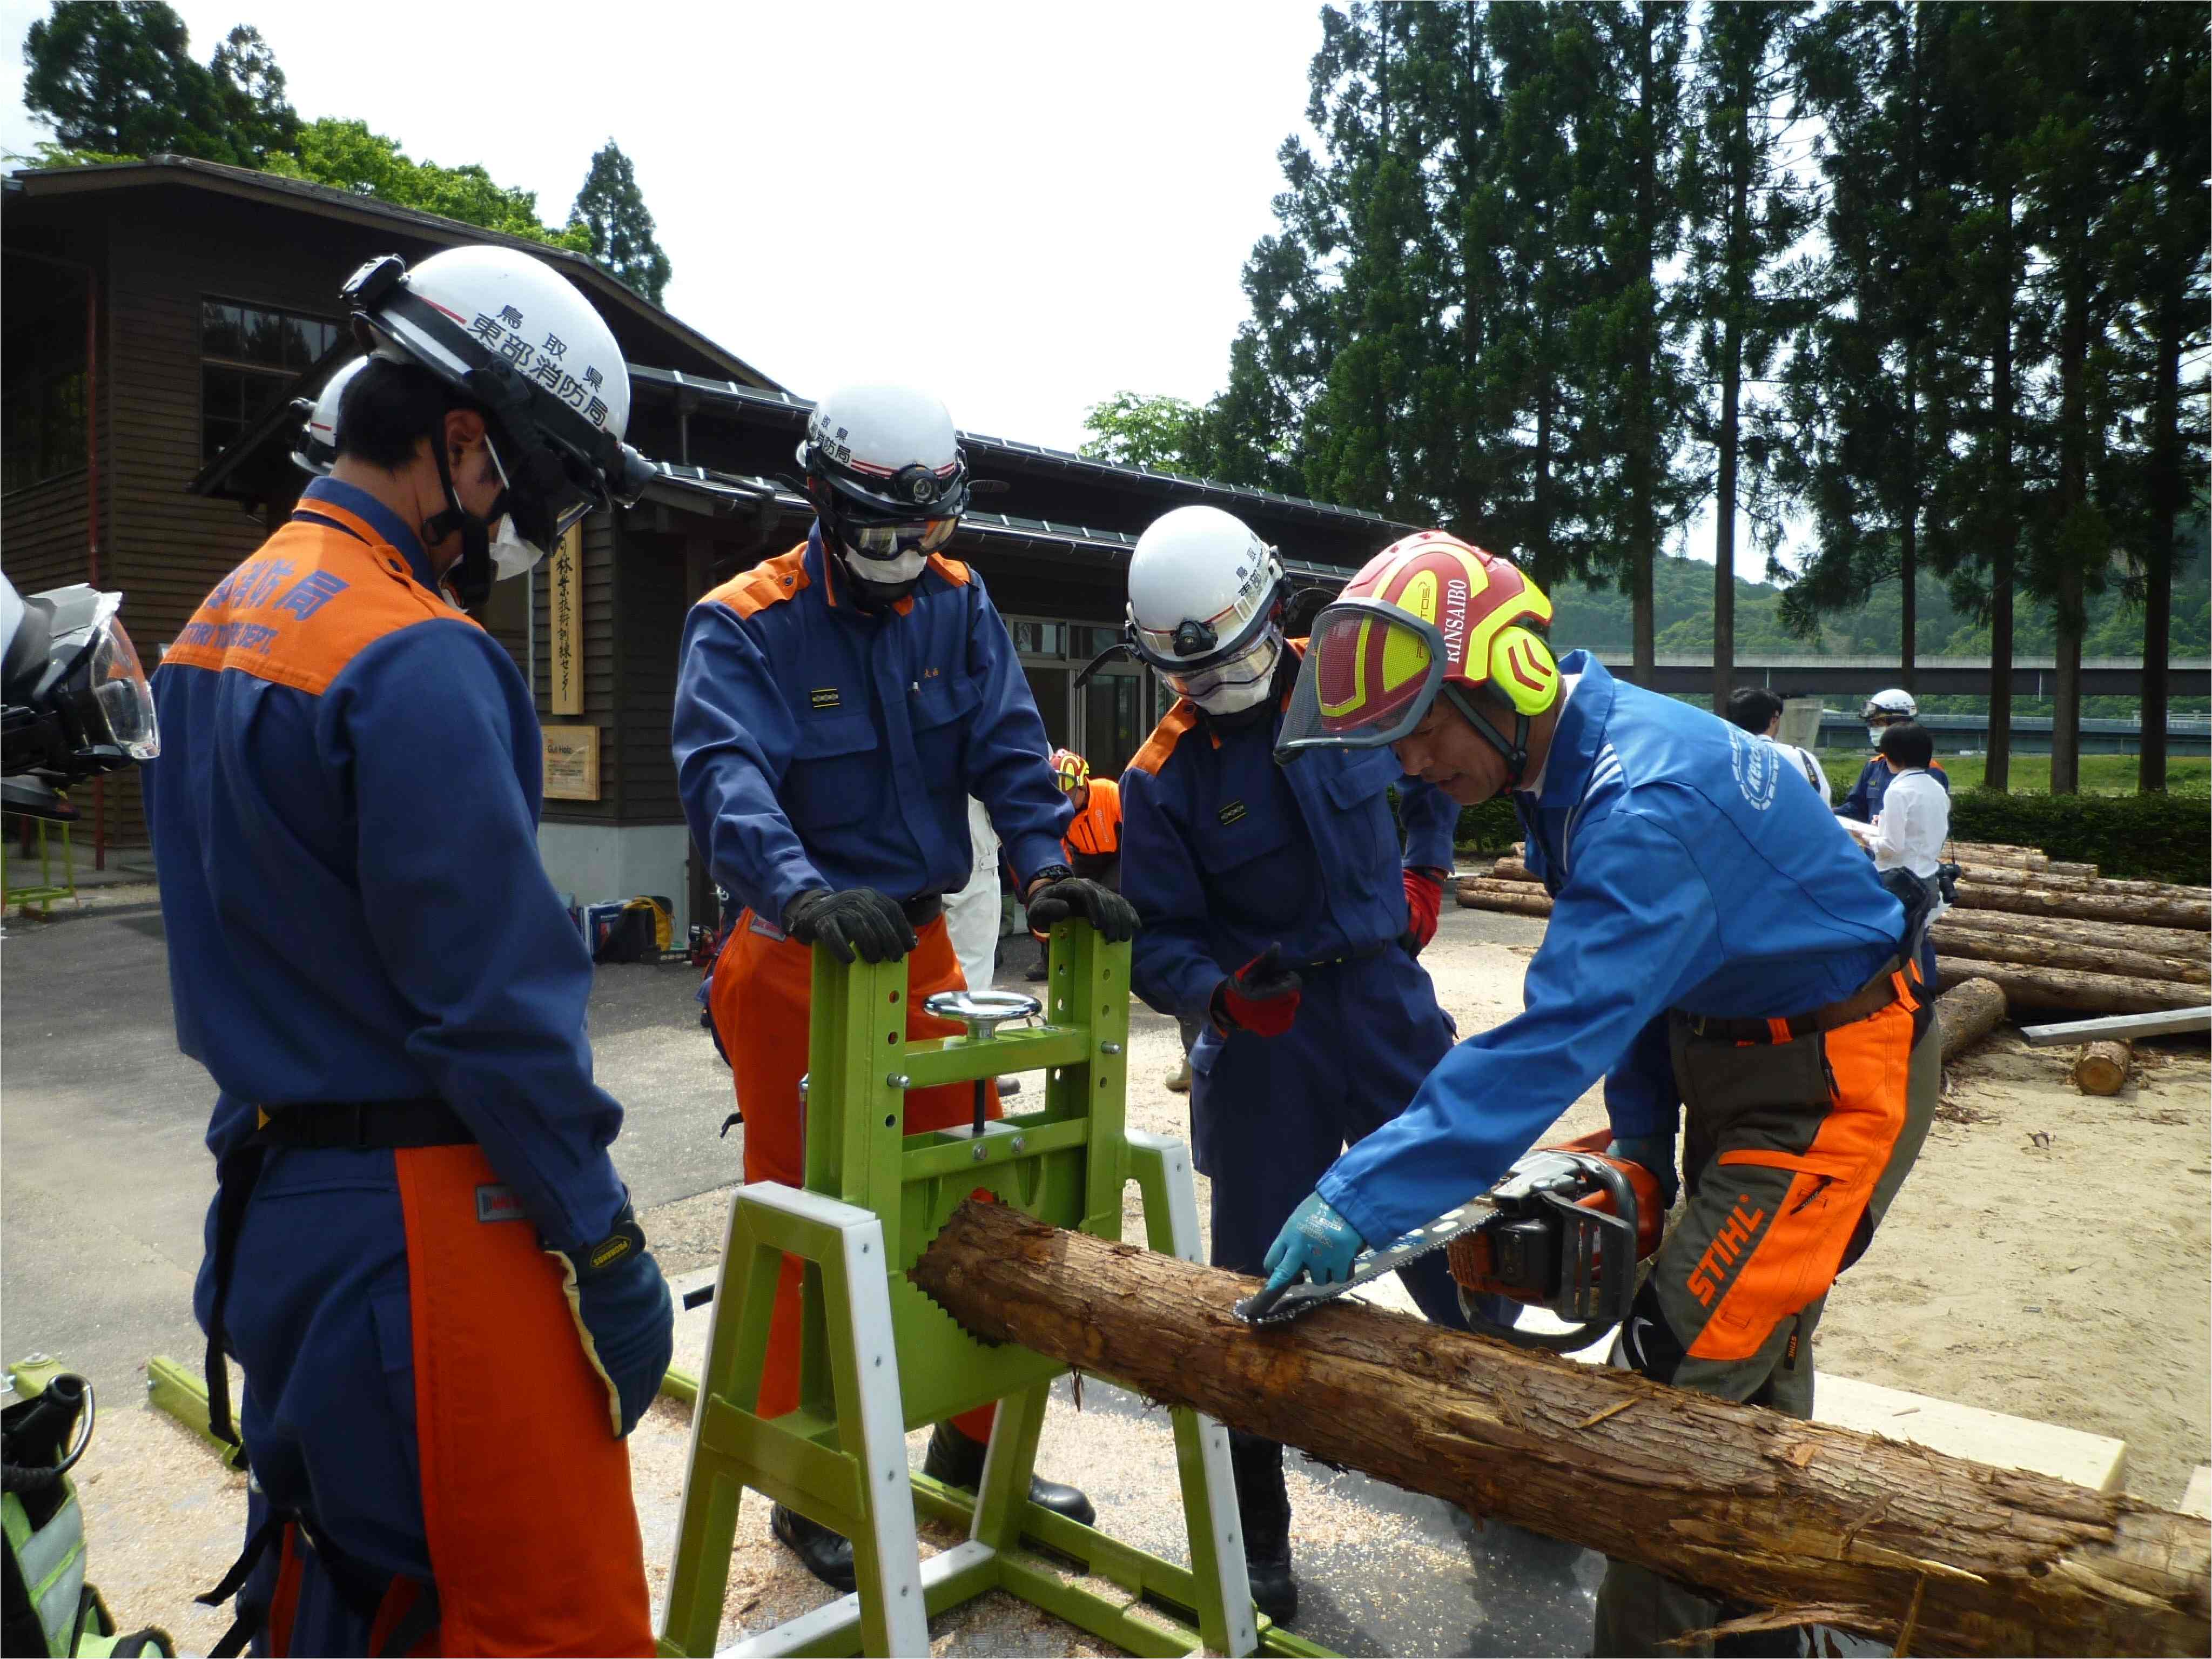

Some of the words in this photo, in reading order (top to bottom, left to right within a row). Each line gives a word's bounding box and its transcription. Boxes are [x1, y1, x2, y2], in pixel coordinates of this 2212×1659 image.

[467, 312, 609, 427] 東部消防局
[496, 305, 603, 393] 鳥取県
[1443, 579, 1467, 664] KINSAIBO
[1686, 1205, 1765, 1307] STIHL
